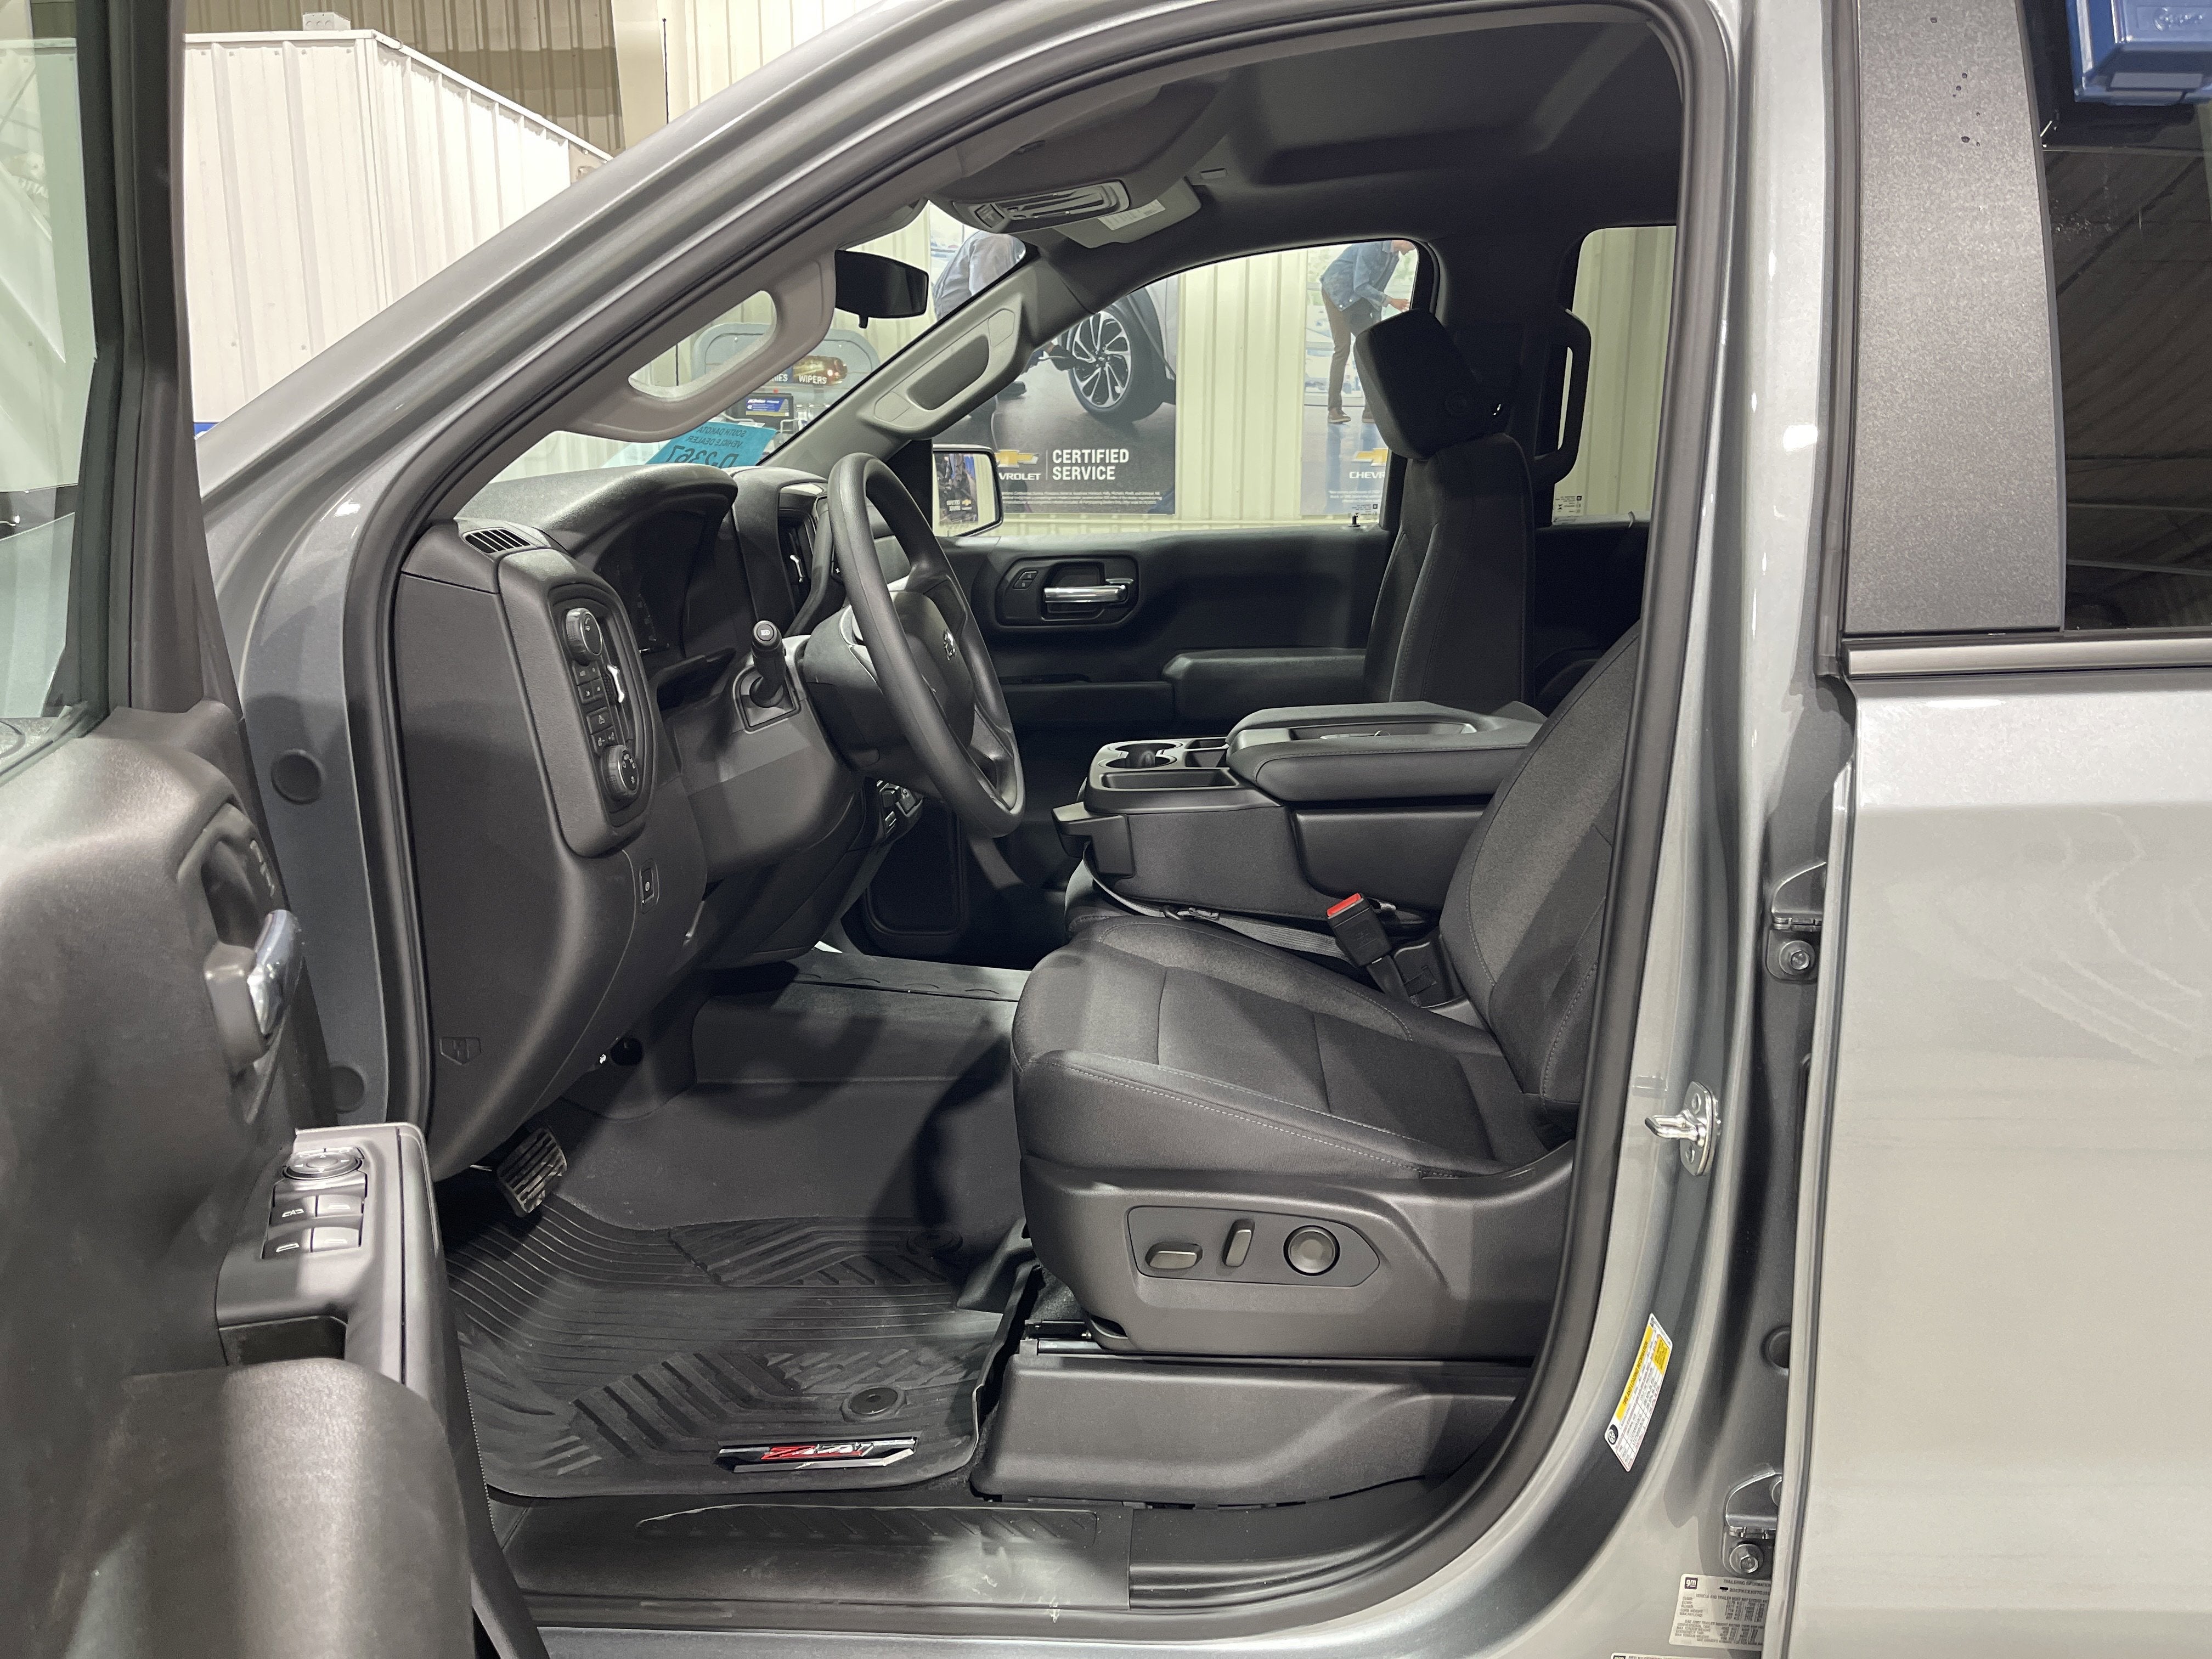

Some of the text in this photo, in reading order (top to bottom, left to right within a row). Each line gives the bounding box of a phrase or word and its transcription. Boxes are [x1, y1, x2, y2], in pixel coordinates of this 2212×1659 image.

[799, 375, 827, 384] WIPERS
[1052, 449, 1129, 464] CERTIFIED
[998, 472, 1042, 481] VROLET
[1052, 466, 1116, 481] SERVICE
[1685, 1579, 1697, 1588] gm
